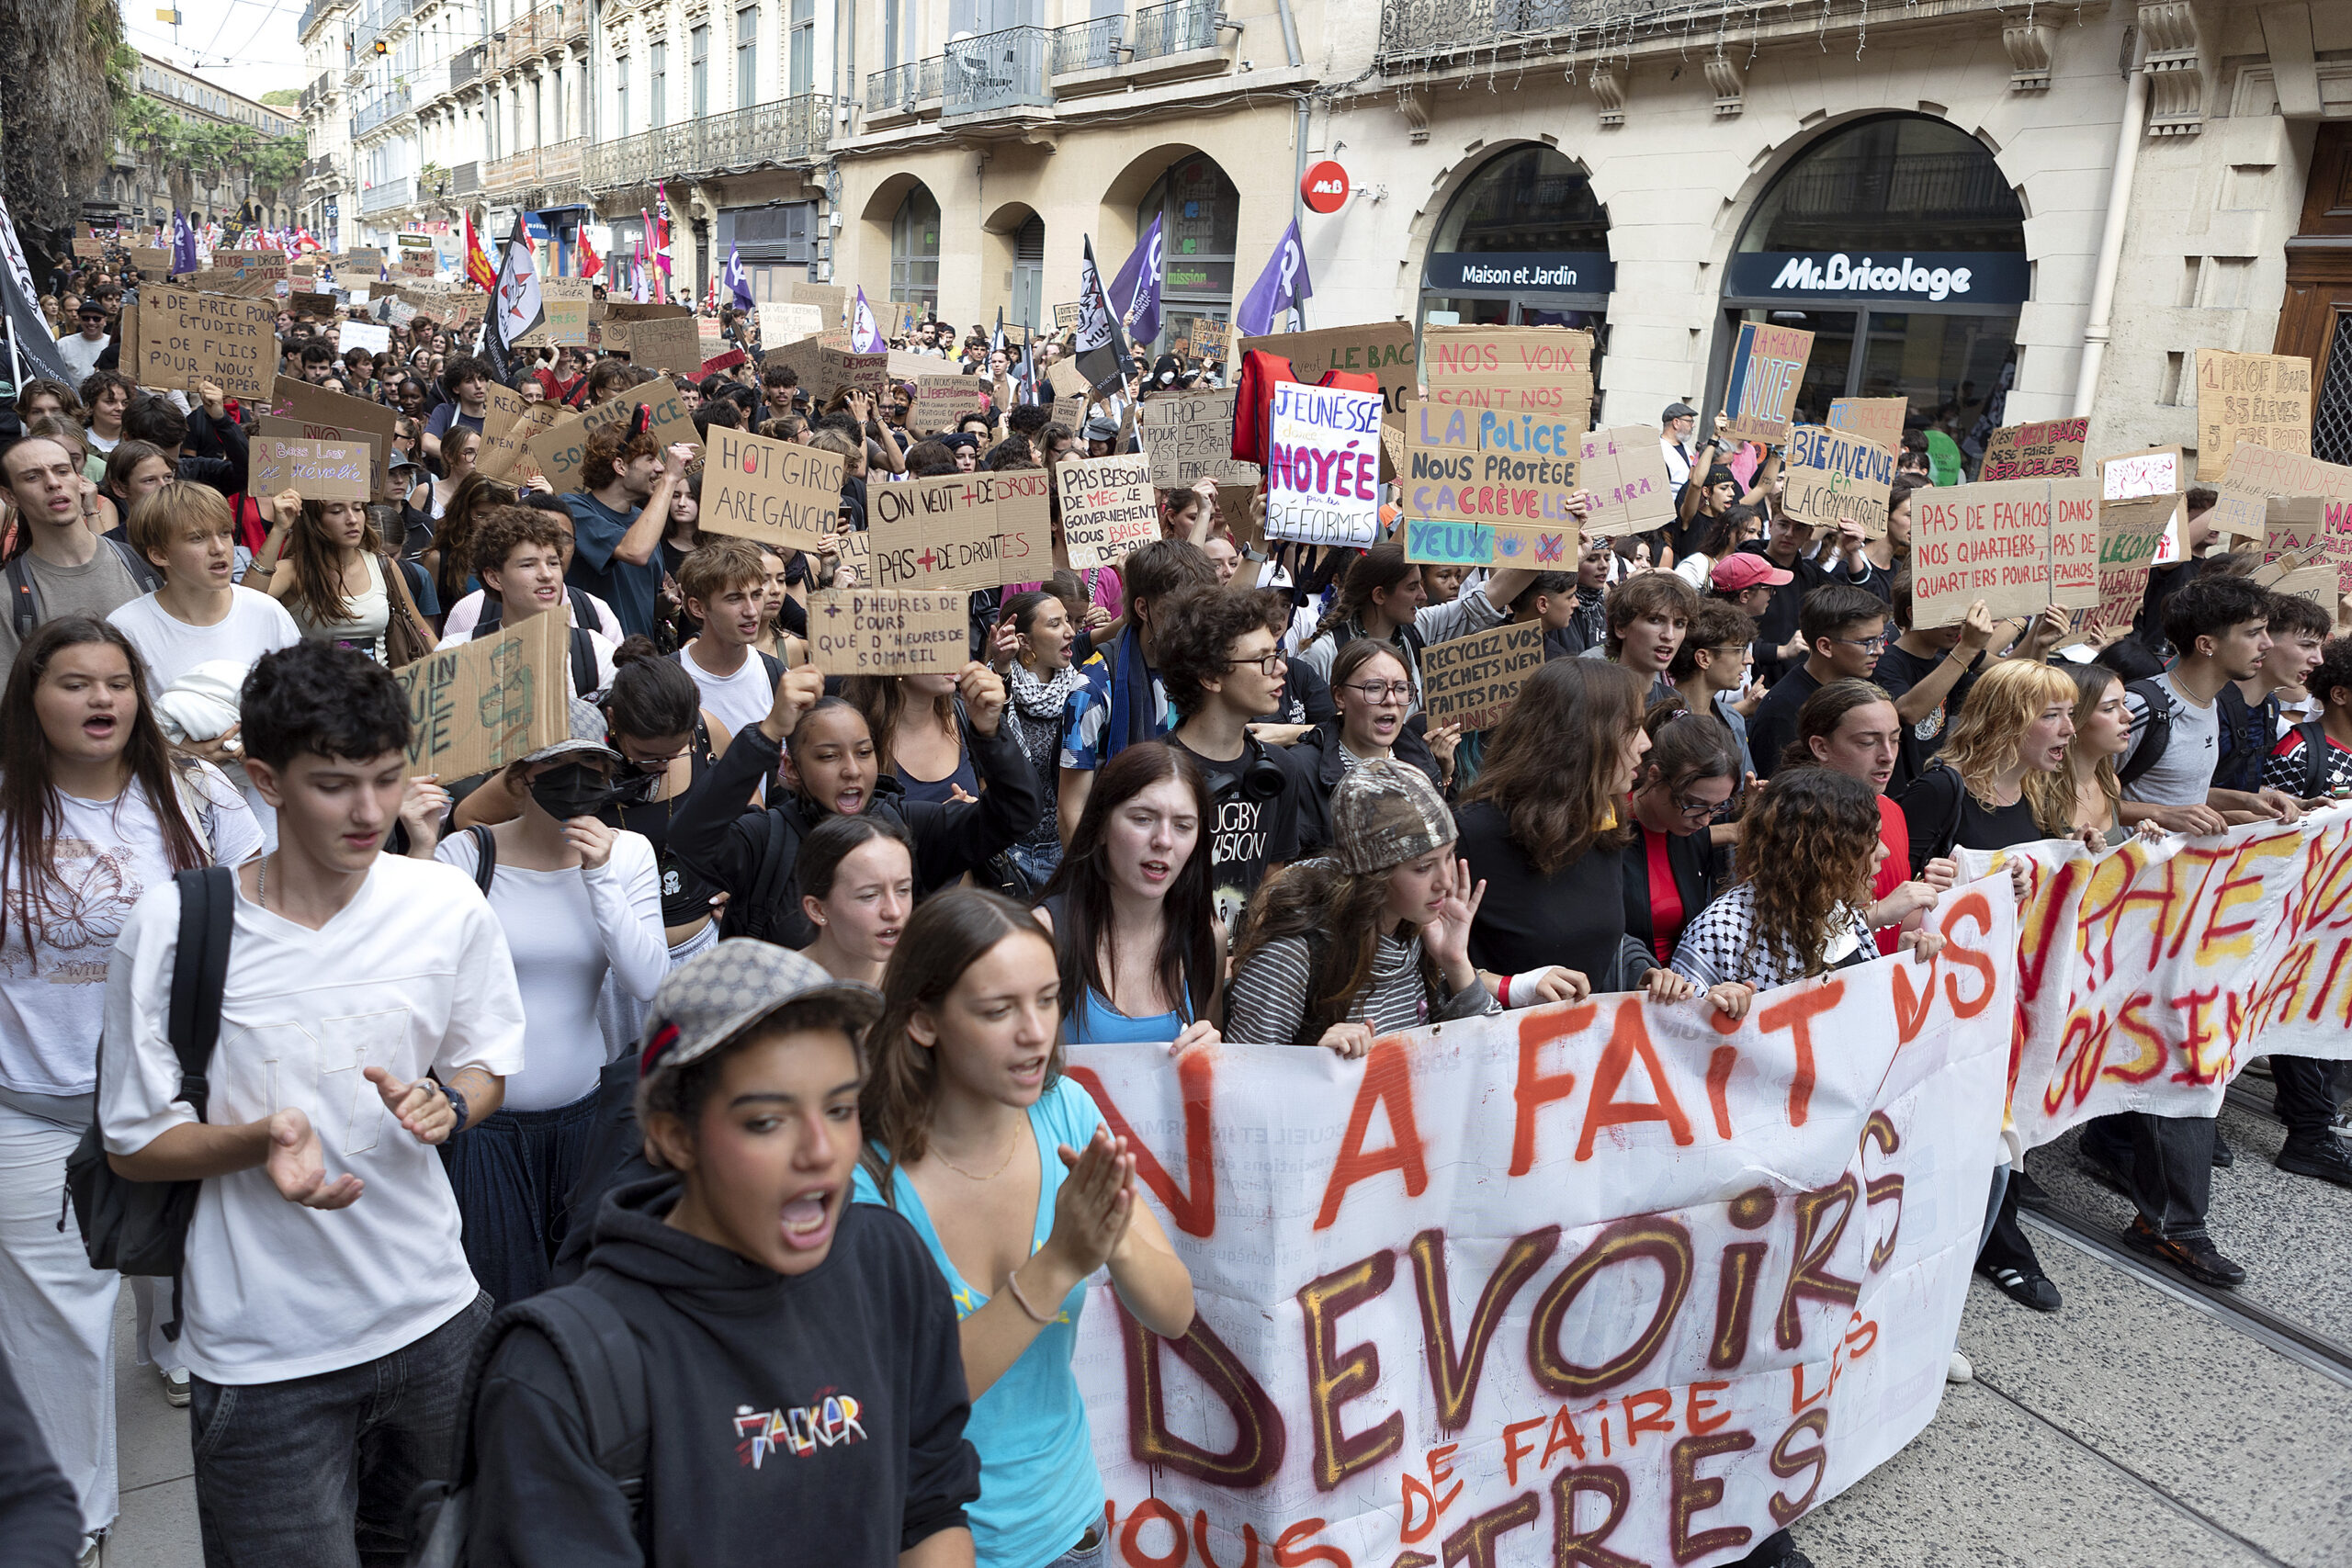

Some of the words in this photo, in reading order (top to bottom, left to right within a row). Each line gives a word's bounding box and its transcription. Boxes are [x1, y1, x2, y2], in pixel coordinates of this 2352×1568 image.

[1462, 265, 1510, 283] Maison
[1512, 268, 1529, 284] et
[1530, 265, 1577, 286] Jardin
[1770, 253, 1973, 301] Mr.Bricolage
[167, 295, 188, 310] DE
[199, 299, 238, 317] FRIC
[246, 306, 276, 324] POUR
[180, 314, 257, 336] ETUDIER
[170, 336, 190, 351] DE
[204, 339, 258, 359] FLICS
[1329, 346, 1362, 369] LE
[1367, 342, 1416, 369] BAC
[1437, 342, 1499, 377] NOS
[1520, 344, 1577, 373] VOIX
[1753, 328, 1769, 355] LA
[1768, 332, 1809, 360] MACRO
[150, 351, 198, 372] POUR
[215, 361, 254, 378] NOUS
[2202, 357, 2219, 389] 1
[2222, 356, 2272, 393] PROF
[2276, 362, 2310, 394] POUR
[493, 395, 555, 428] RECYCLEZ
[1159, 400, 1206, 424] TROP
[1275, 389, 1383, 434] JEUNESSE
[1437, 388, 1511, 410] SONT
[1521, 387, 1564, 410] NOS
[2224, 396, 2250, 425] 35
[1148, 424, 1179, 444] POUR
[1419, 406, 1467, 446] LA
[2271, 427, 2309, 456] POUR
[722, 436, 775, 479] HOT
[782, 451, 843, 493] GIRLS
[1149, 442, 1196, 461] ASSEZ
[2004, 448, 2019, 461] SE
[1062, 468, 1099, 494] PAS
[1152, 464, 1170, 480] SE
[1180, 459, 1214, 480] FAIRE
[1272, 438, 1376, 502] NOYÉE
[1411, 451, 1475, 483] NOUS
[1484, 457, 1577, 489] PROTÈGE
[2230, 446, 2352, 499] APPRENDRE
[714, 486, 757, 524] ARE
[877, 489, 915, 524] ON
[920, 483, 964, 516] VEUT
[976, 478, 995, 504] DE
[996, 474, 1048, 501] DROITS
[1063, 495, 1083, 512] DE
[1126, 488, 1142, 502] LE
[1306, 493, 1323, 506] par
[1412, 484, 1457, 524] ÇA
[1458, 483, 1541, 520] CRÈVE
[1064, 504, 1158, 530] GOUVERNEMENT
[1265, 498, 1375, 544] RÉFORMES
[1922, 503, 1959, 536] PAS
[1966, 504, 1986, 532] DE
[1993, 501, 2050, 532] FACHOS
[2058, 499, 2094, 524] DANS
[1066, 529, 1104, 545] NOUS
[1408, 522, 1488, 559] YEUX
[1918, 541, 1950, 569] NOS
[2053, 533, 2075, 557] PAS
[2081, 533, 2097, 555] DE
[876, 547, 917, 587] PAS
[936, 544, 956, 571] DE
[959, 532, 1030, 568] DROITES
[1917, 567, 1997, 599] QUARTIERS
[2002, 565, 2031, 586] POUR
[2031, 563, 2050, 583] LES
[2052, 562, 2095, 582] FACHOS
[853, 596, 932, 615] D'HEURES
[940, 597, 958, 612] DE
[854, 615, 905, 631] COURS
[819, 634, 858, 656] QUE
[948, 628, 965, 642] DE
[856, 648, 938, 668] SOMMEIL
[1425, 634, 1503, 674] RECYCLEZ
[1505, 626, 1544, 649] VOS
[1426, 658, 1501, 694] DECHETS
[1504, 649, 1542, 675] N'EN
[1428, 684, 1486, 717] FAITES
[1490, 680, 1520, 704] PAS
[1312, 1036, 1430, 1232] A
[1103, 1495, 1355, 1568] OUS
[1400, 1443, 1464, 1544] DE
